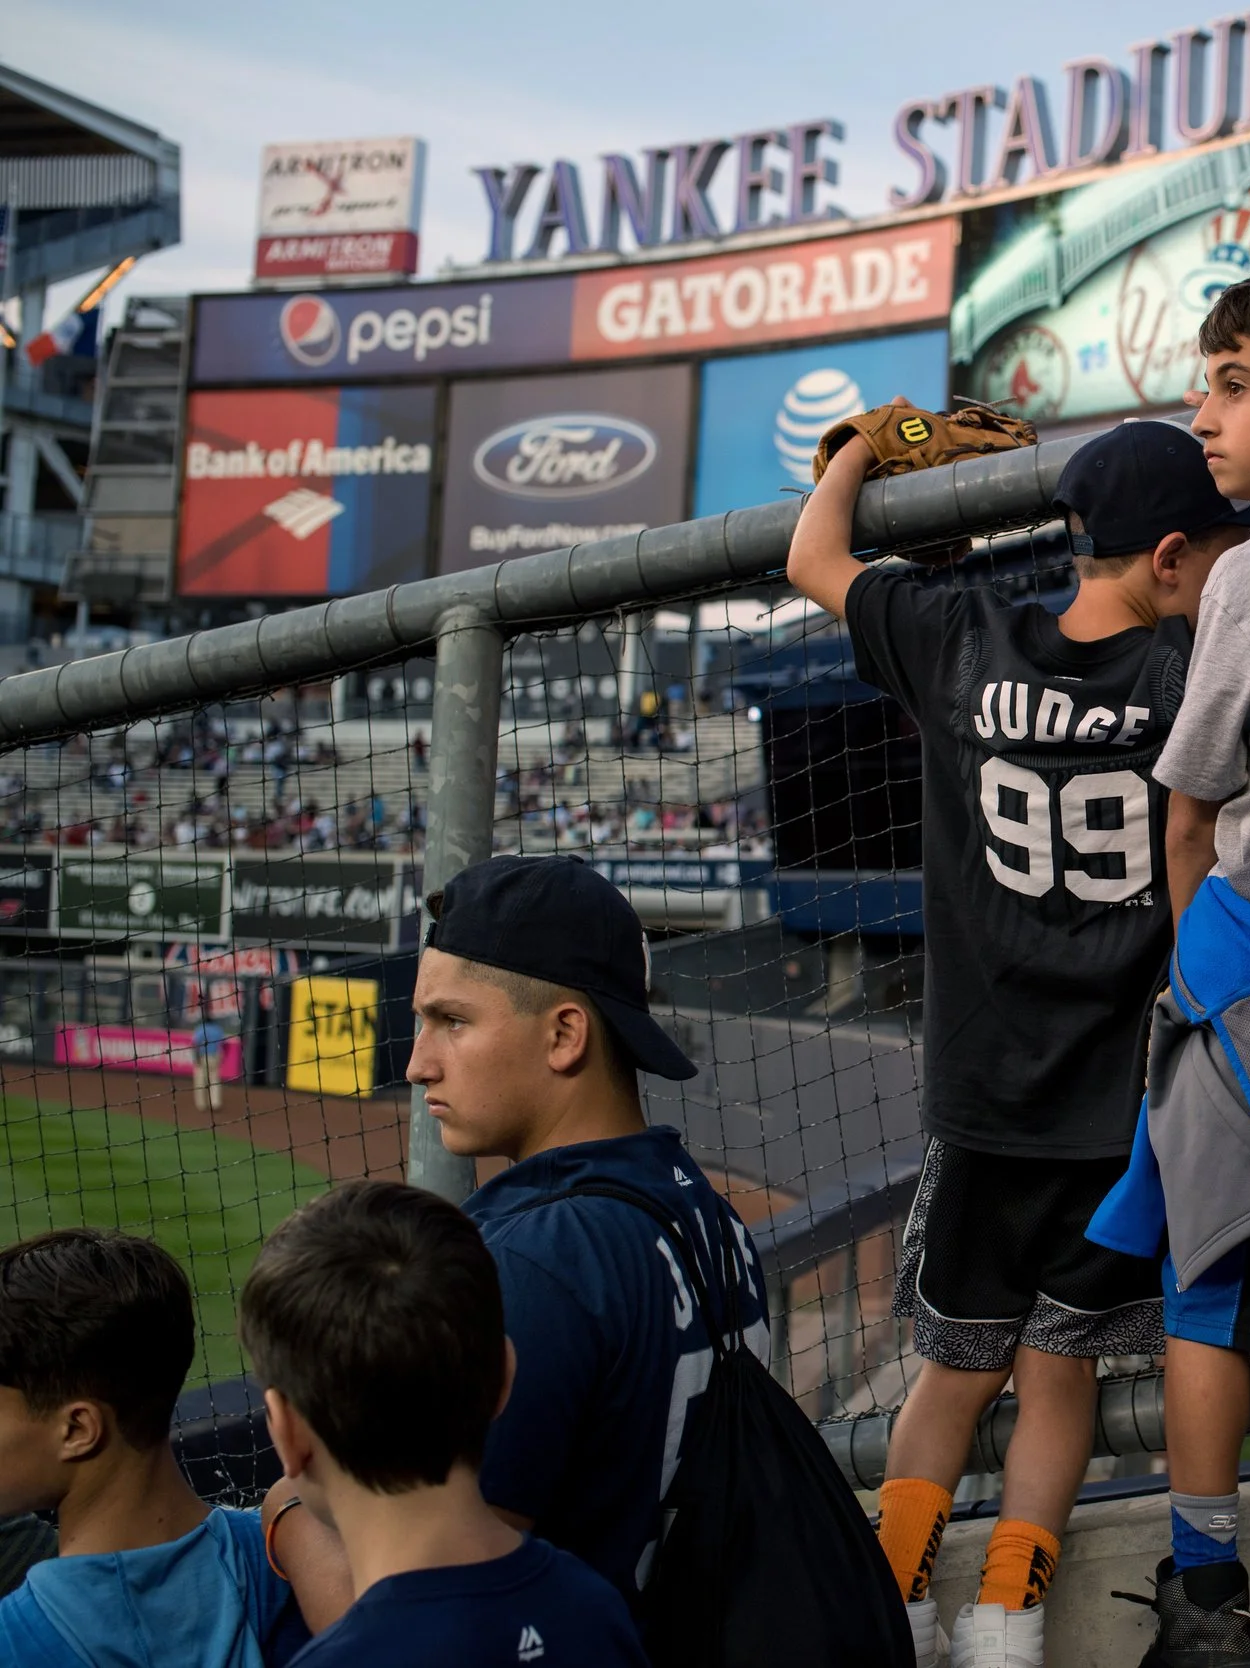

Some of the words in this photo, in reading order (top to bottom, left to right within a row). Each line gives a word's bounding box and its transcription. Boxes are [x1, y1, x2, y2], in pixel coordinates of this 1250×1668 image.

[472, 118, 847, 263] YANKEE
[264, 235, 395, 263] ARMITRON
[598, 239, 931, 343] GATORADE
[348, 294, 492, 364] pepsi
[187, 441, 265, 479] Bank
[266, 438, 304, 477] of
[302, 433, 432, 477] America
[507, 425, 622, 485] Ford
[974, 680, 1150, 747] JUDGE
[980, 756, 1153, 902] 99
